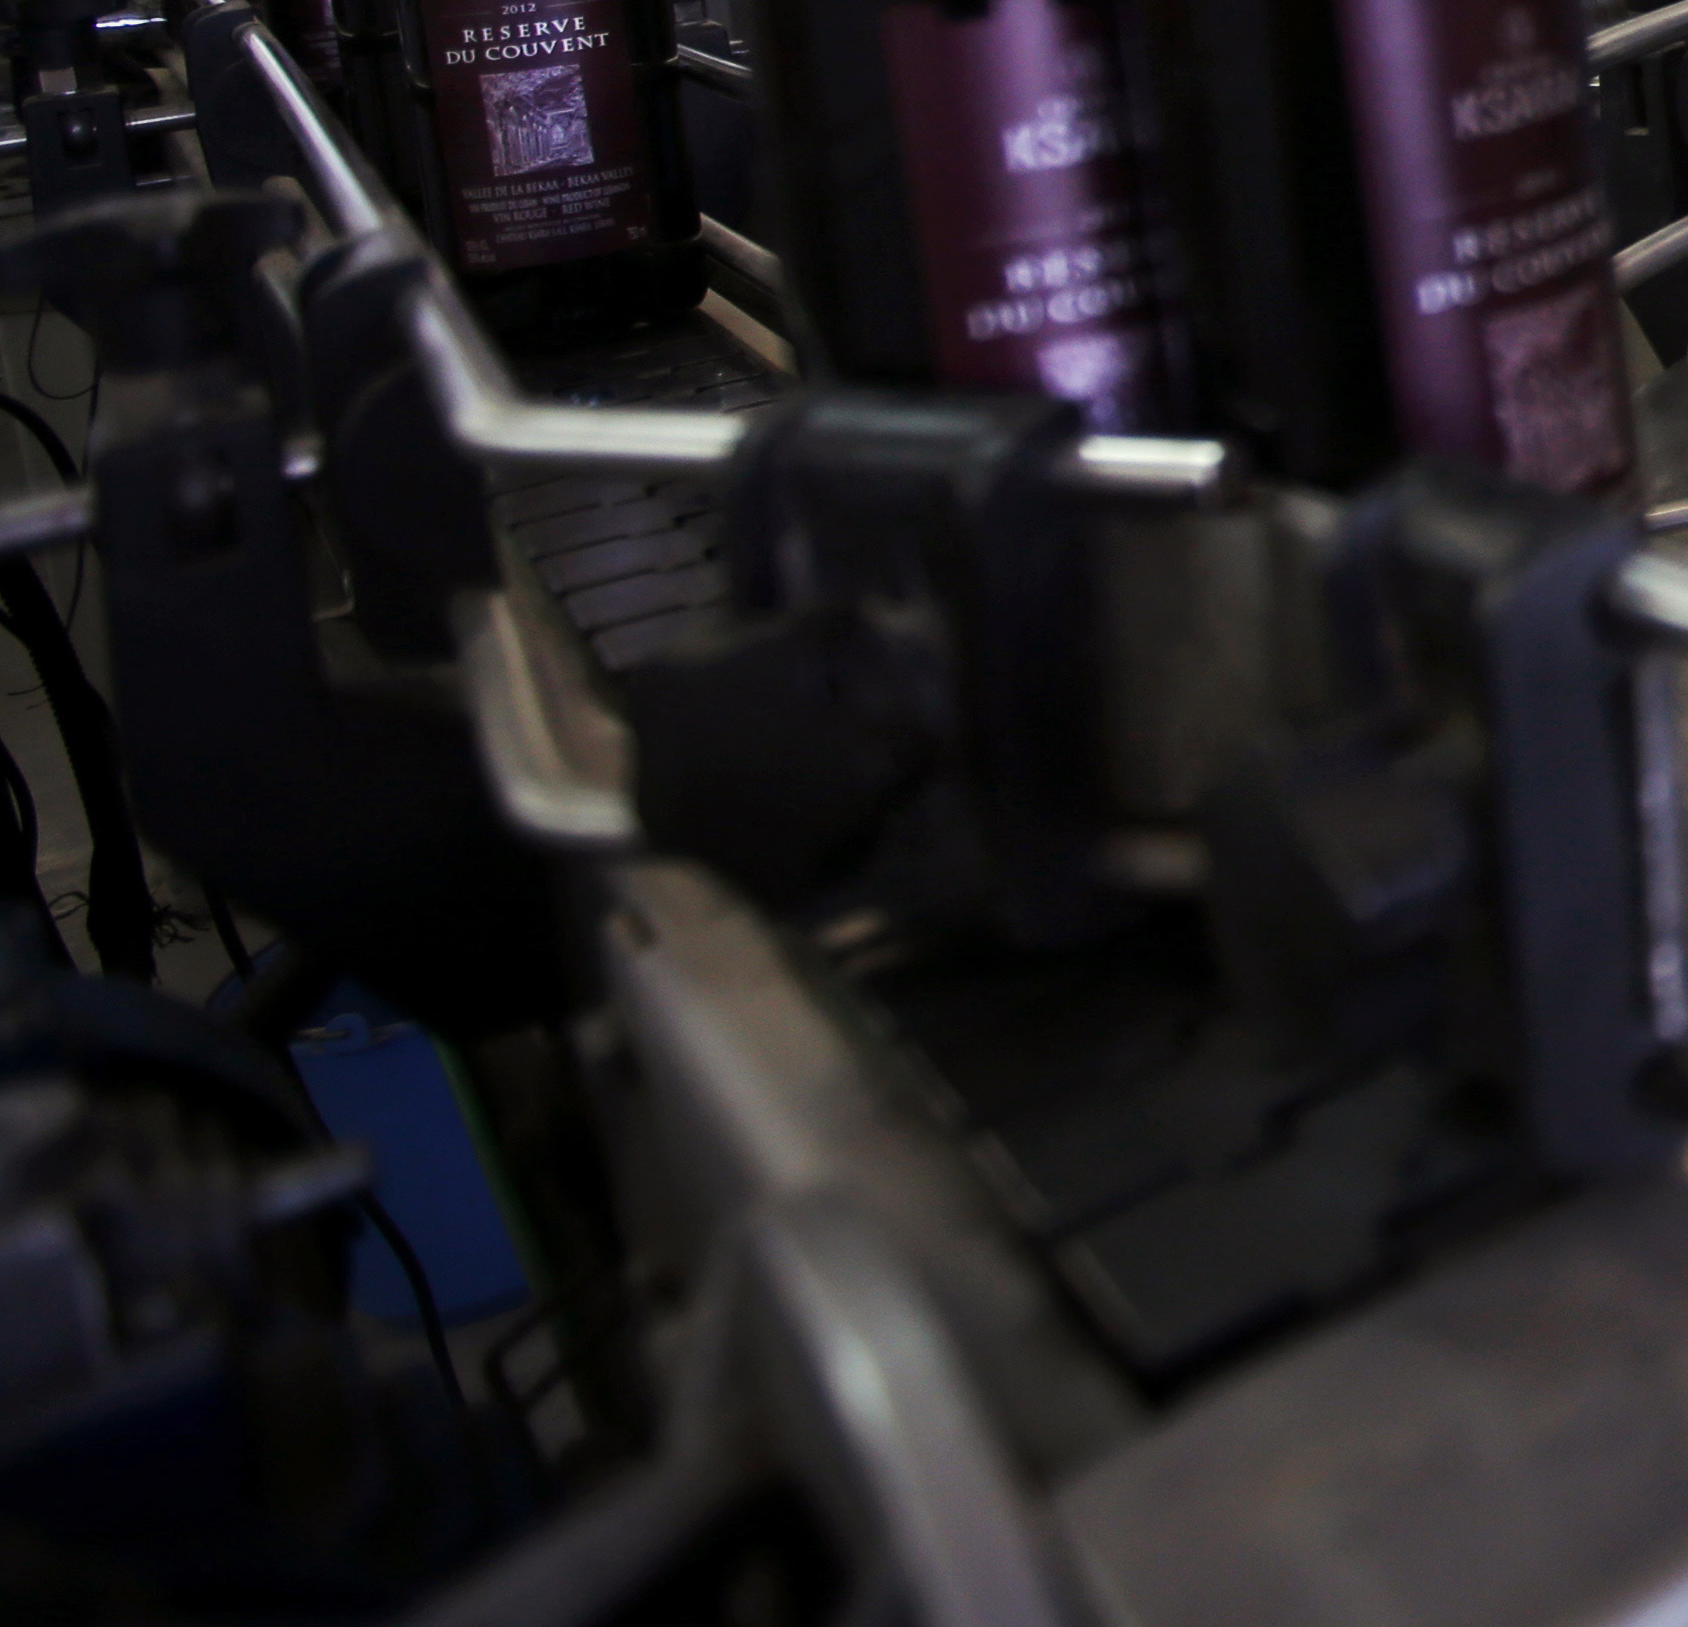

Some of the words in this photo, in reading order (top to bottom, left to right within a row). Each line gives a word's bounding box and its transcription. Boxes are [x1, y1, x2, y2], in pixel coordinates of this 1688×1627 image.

[501, 2, 537, 15] 2012
[463, 16, 586, 43] RESERVE
[446, 49, 476, 65] DU
[485, 32, 610, 61] COUVENT
